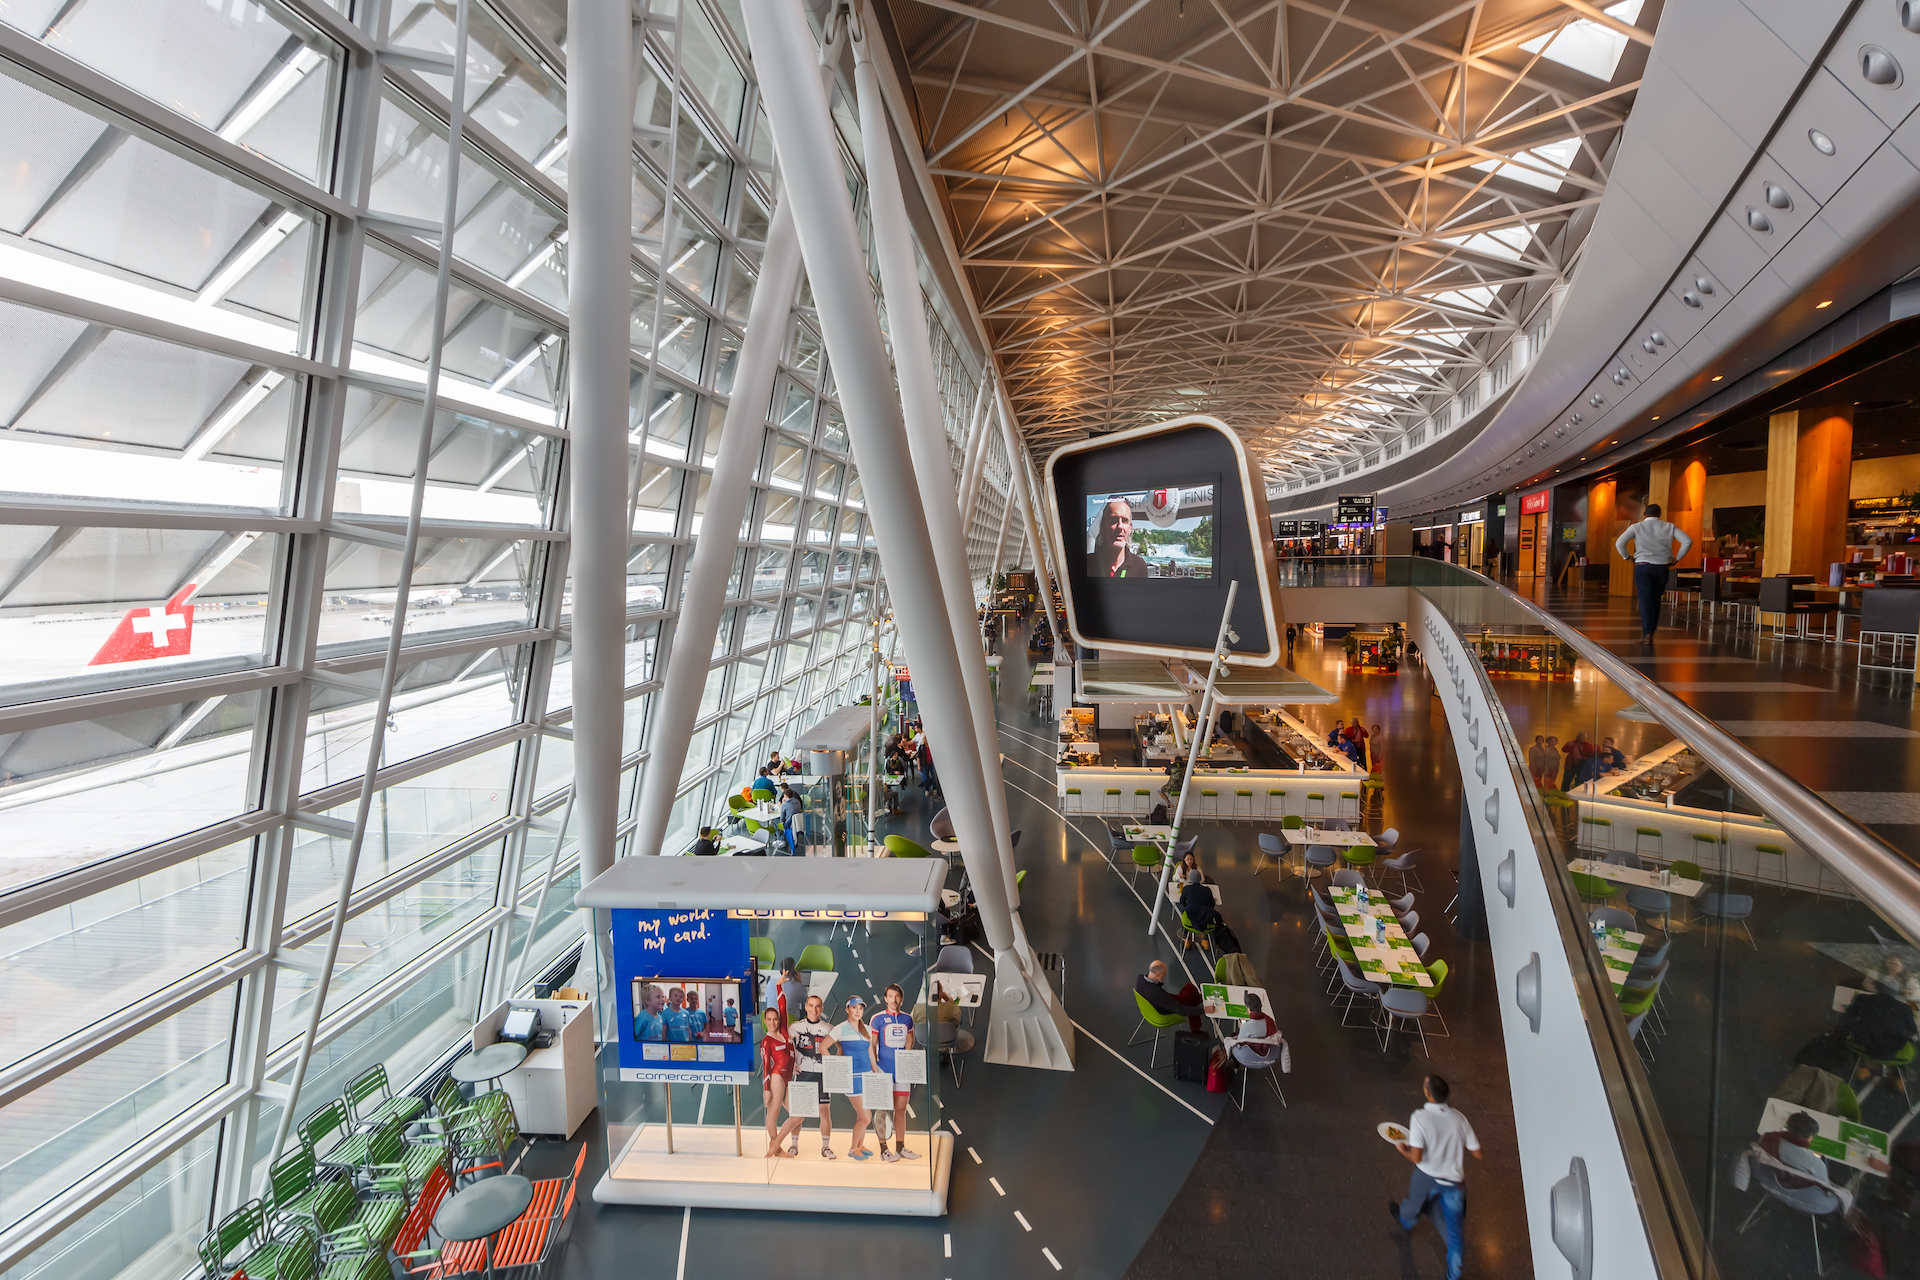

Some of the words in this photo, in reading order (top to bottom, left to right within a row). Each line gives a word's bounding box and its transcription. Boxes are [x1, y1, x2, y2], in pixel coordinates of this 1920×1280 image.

[638, 918, 661, 937] my
[668, 908, 715, 926] world.
[643, 936, 666, 954] my
[673, 922, 711, 943] card.
[636, 1072, 733, 1082] cornercard.ch
